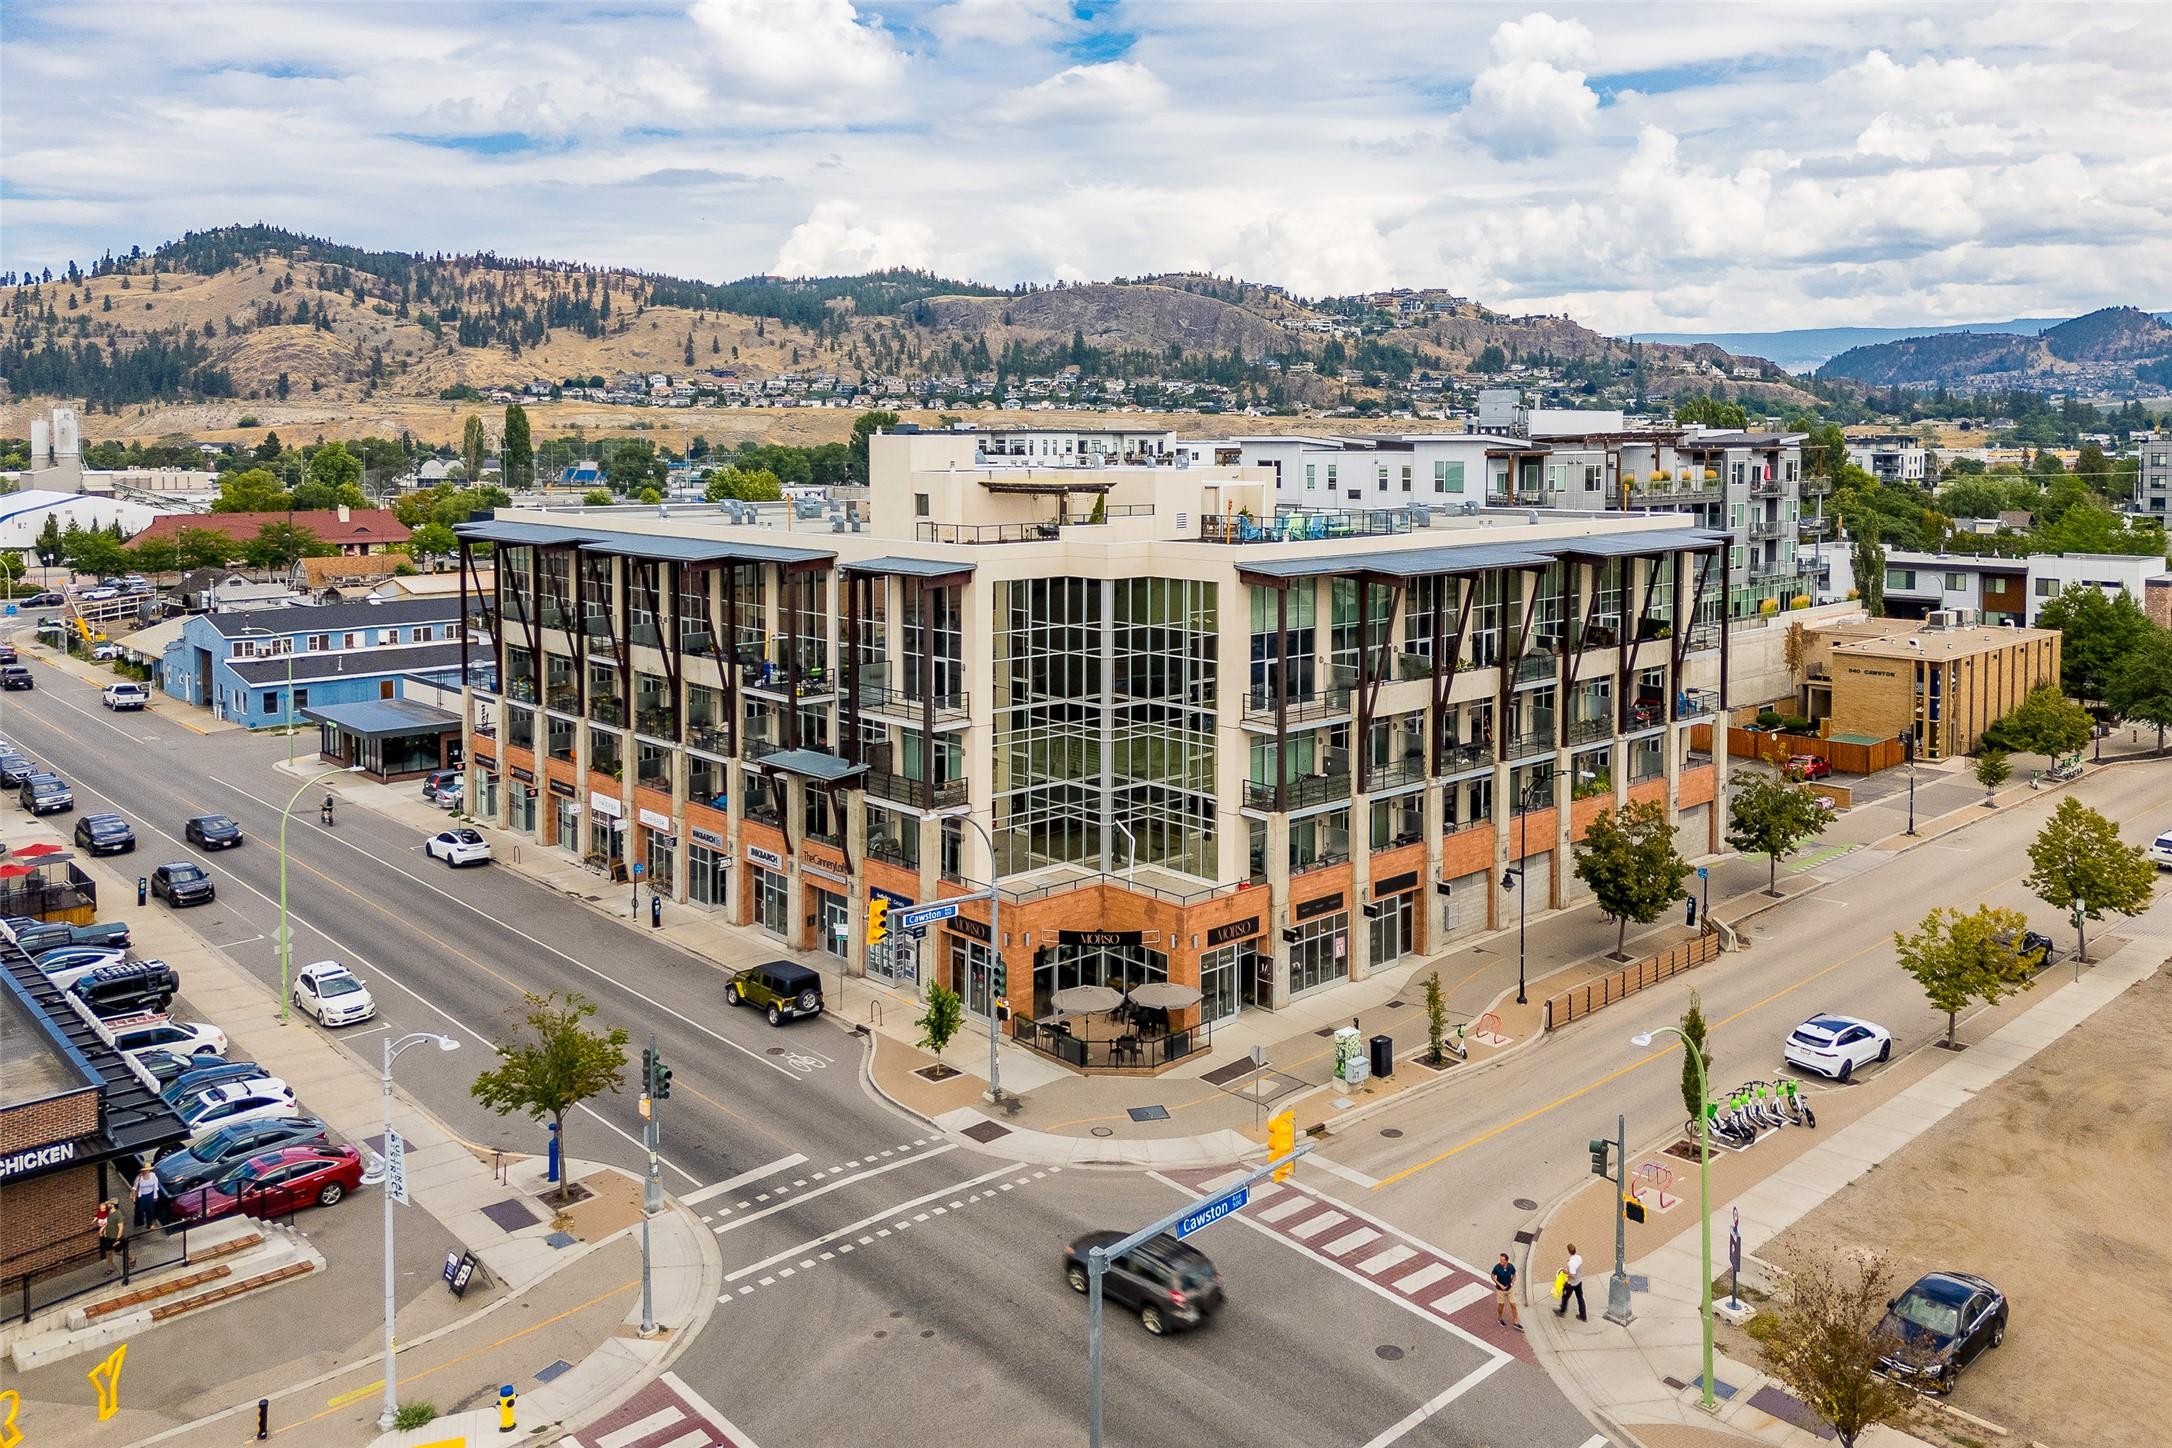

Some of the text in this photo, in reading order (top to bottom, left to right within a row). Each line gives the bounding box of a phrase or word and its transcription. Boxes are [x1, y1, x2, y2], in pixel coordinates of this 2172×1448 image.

[909, 910, 941, 924] Cawston
[954, 916, 985, 938] MORSO
[1080, 933, 1120, 944] MORSO
[1217, 920, 1251, 941] MORSO
[0, 1143, 74, 1177] CHICKEN
[1232, 1194, 1242, 1202] Ave
[1183, 1202, 1228, 1232] Cawston
